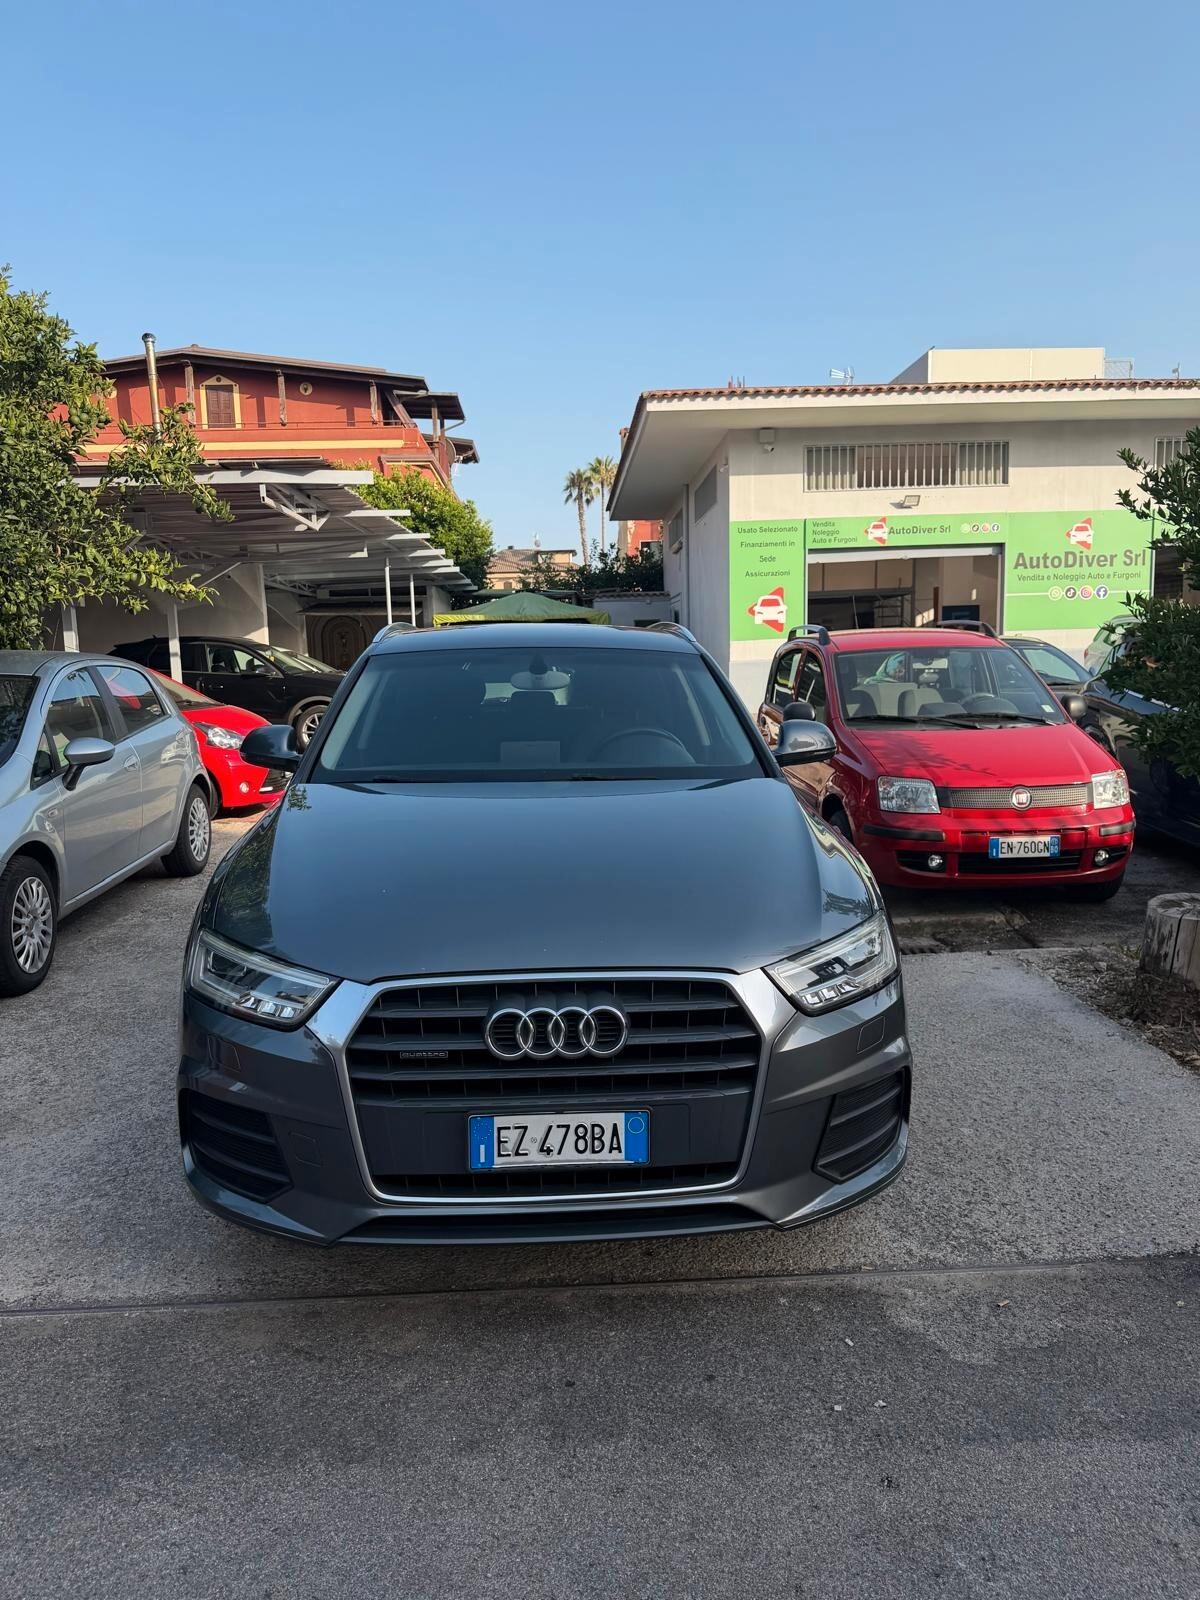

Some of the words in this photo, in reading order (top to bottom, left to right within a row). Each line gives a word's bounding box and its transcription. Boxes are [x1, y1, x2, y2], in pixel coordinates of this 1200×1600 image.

[888, 525, 937, 536] AutoDiver
[939, 525, 951, 533] Srl
[834, 536, 858, 544] Furgoni
[759, 555, 776, 563] Sede
[1013, 551, 1117, 569] AutoDiver
[1123, 549, 1146, 567] Srl
[745, 570, 791, 578] Assicurazioni
[1017, 574, 1045, 582] Vendita
[1053, 573, 1086, 582] Noleggio
[1113, 571, 1141, 580] Furgoni
[1000, 842, 1013, 854] EN
[1017, 840, 1049, 854] 760GN
[497, 1126, 529, 1158] EZ
[539, 1122, 623, 1156] 478BA
